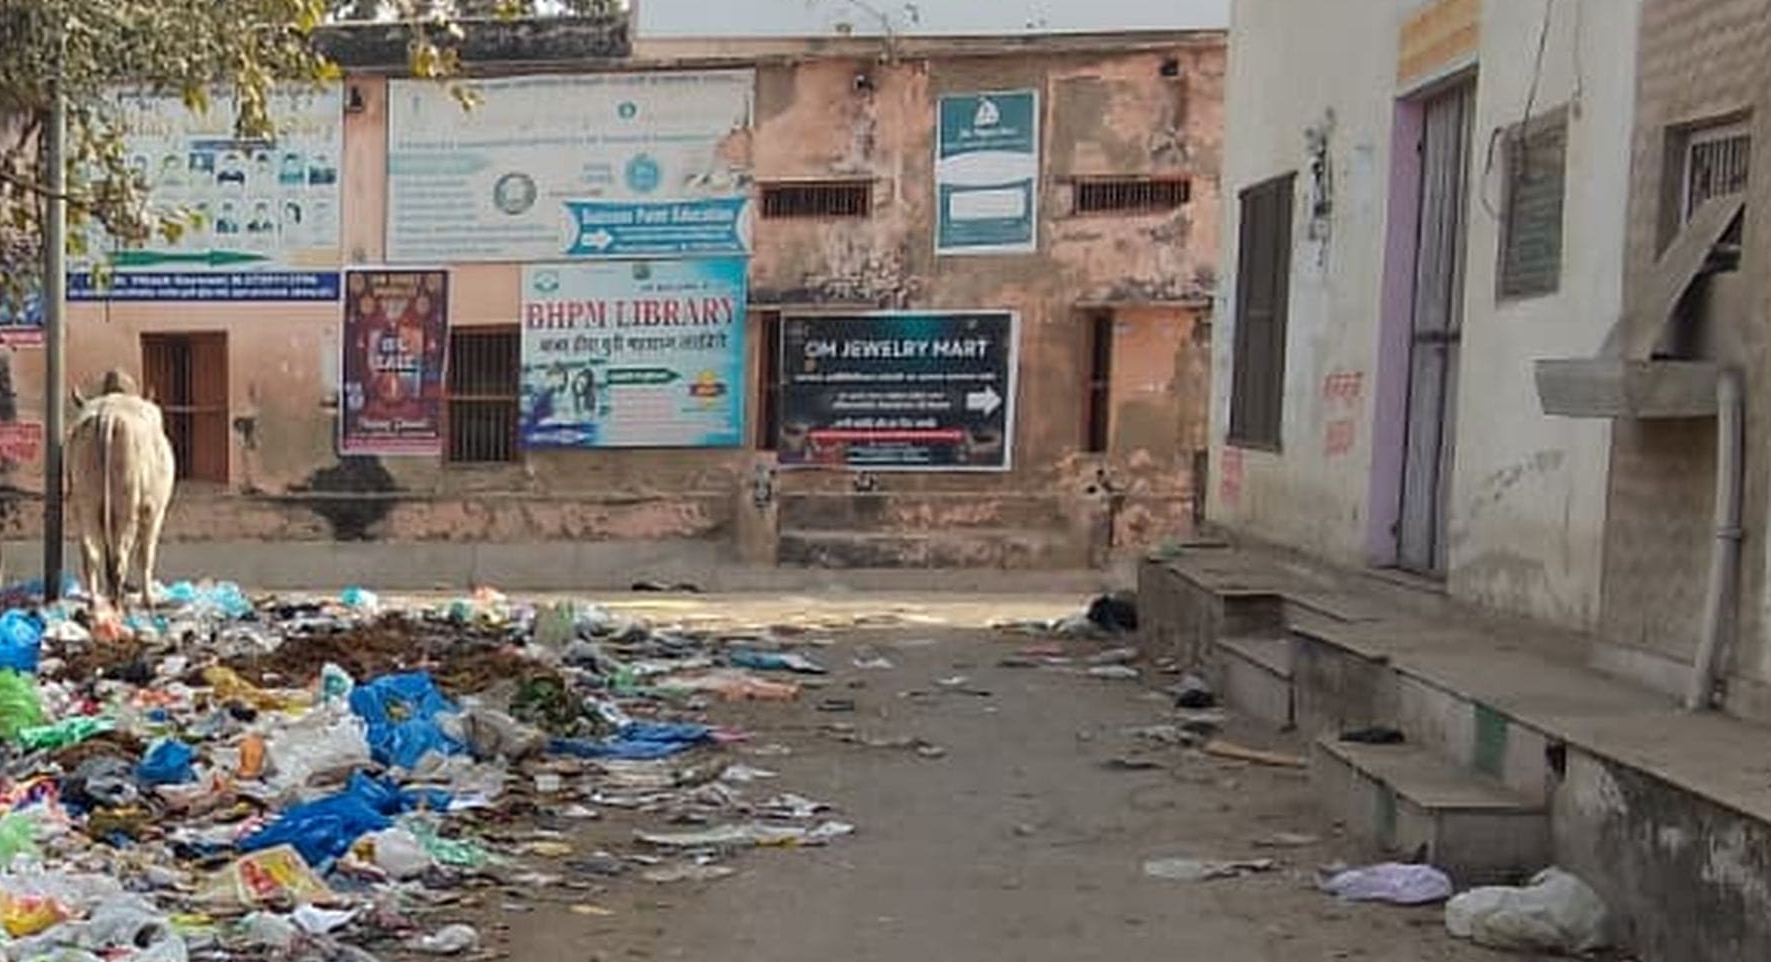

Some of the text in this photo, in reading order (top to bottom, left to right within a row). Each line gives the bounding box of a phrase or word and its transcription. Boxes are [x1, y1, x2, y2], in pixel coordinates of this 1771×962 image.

[527, 296, 734, 329] BHPM LIBRARY
[804, 339, 990, 358] OM JEWELRY MART
